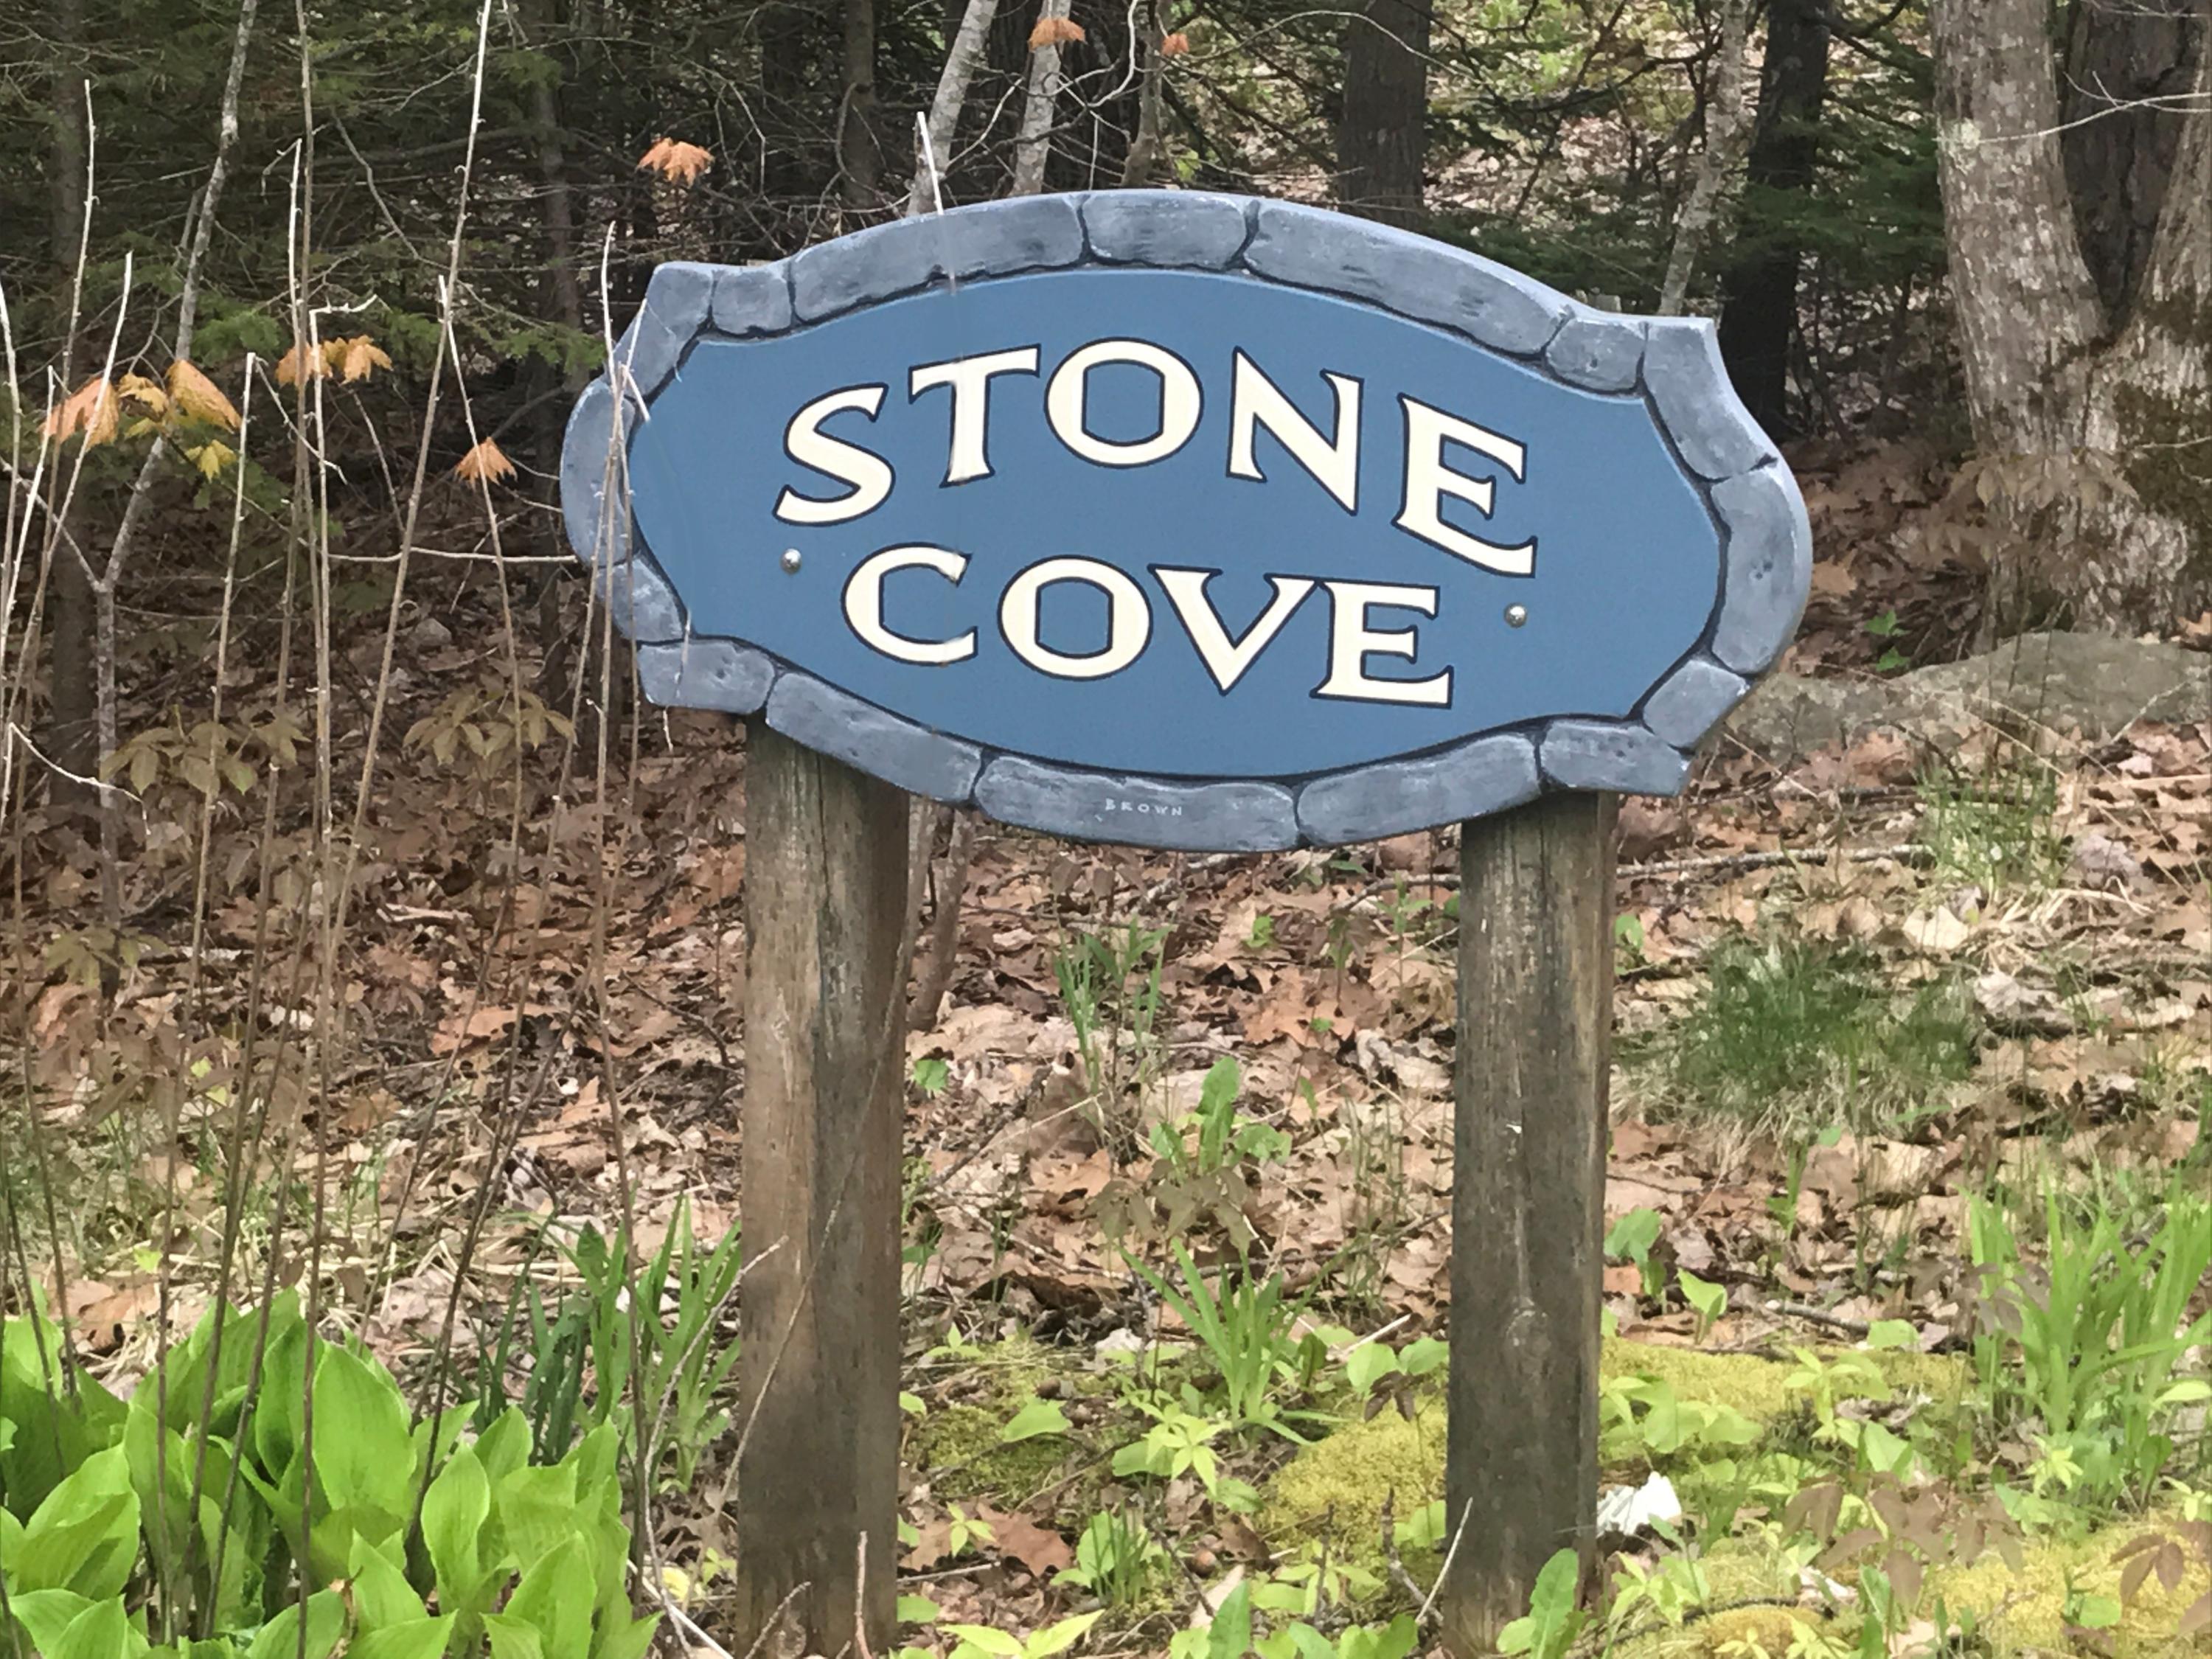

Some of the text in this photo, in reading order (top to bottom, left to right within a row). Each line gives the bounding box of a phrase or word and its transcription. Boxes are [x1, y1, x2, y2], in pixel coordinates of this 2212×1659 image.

[776, 340, 1534, 575] STONE
[844, 546, 1450, 705] COVE
[1105, 797, 1182, 816] BROWN
